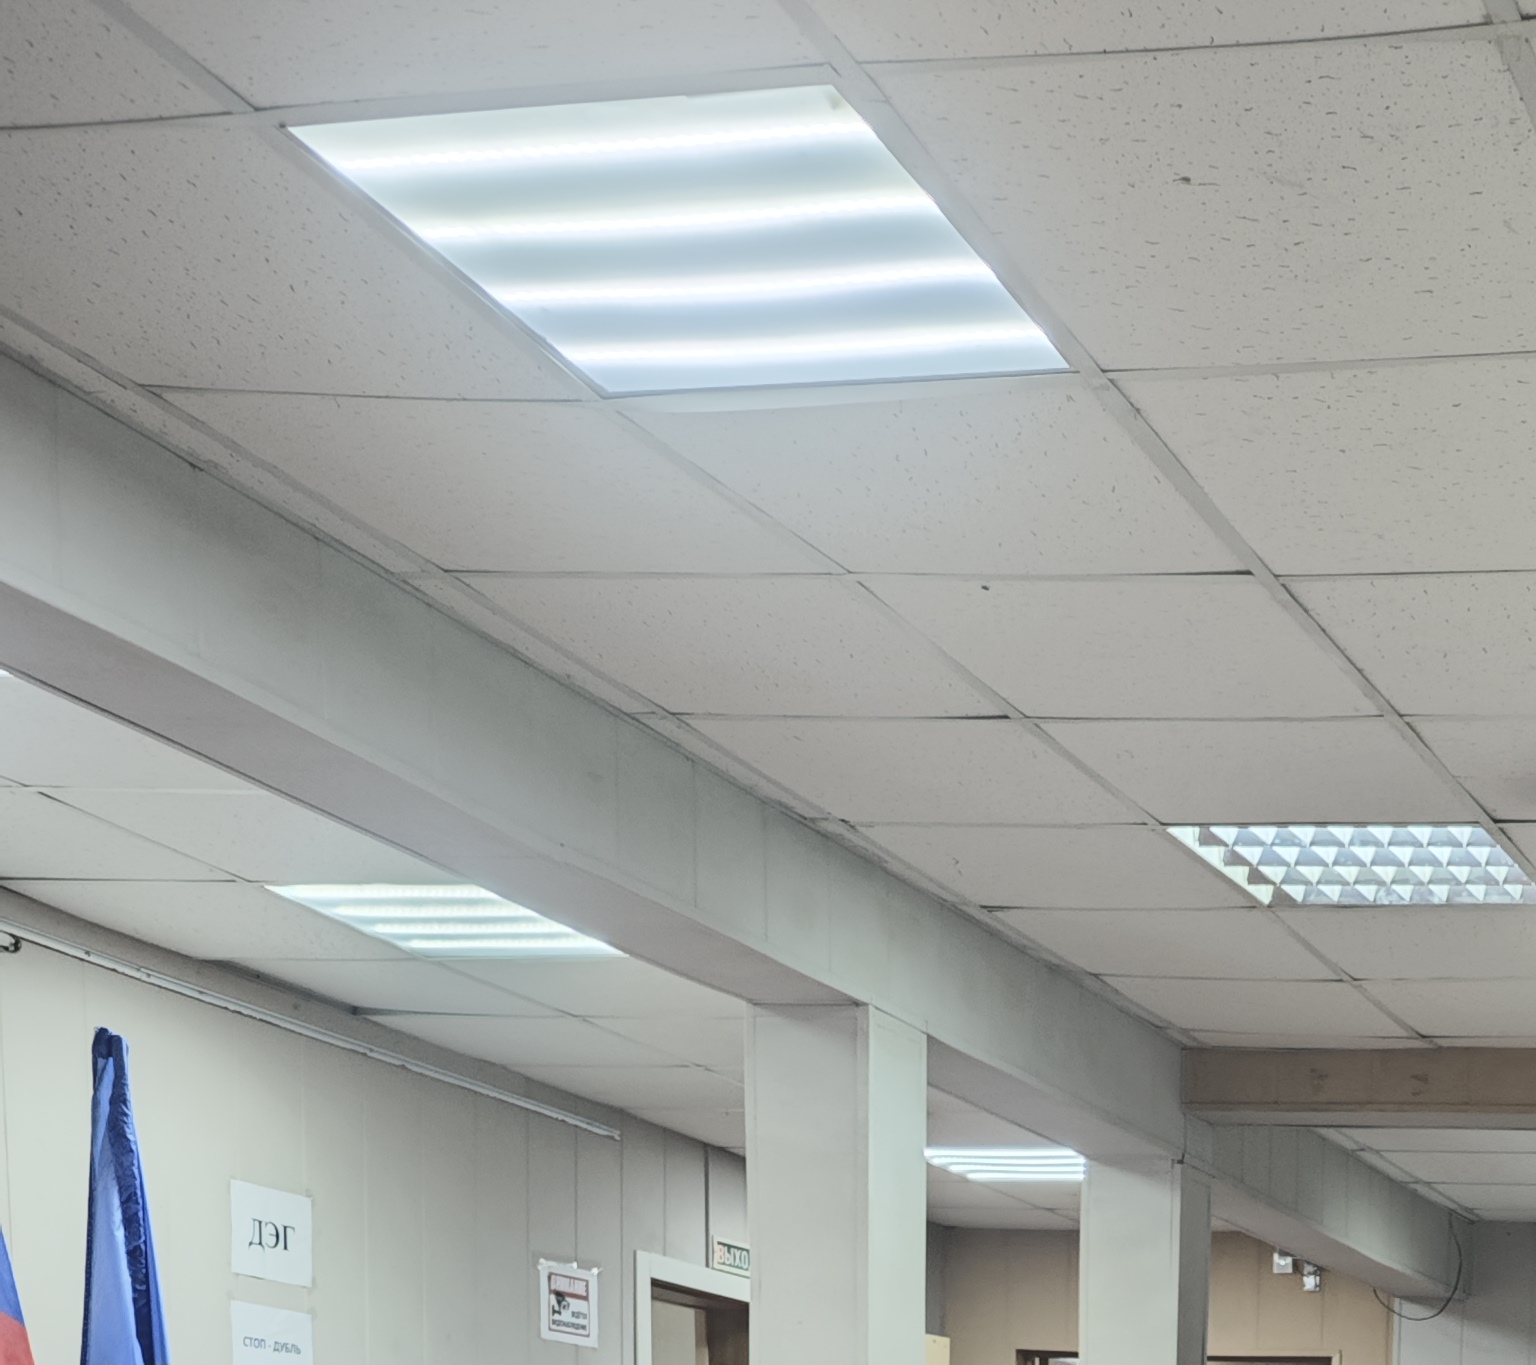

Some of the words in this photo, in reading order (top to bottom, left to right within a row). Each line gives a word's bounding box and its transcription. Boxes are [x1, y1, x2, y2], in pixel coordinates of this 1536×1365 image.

[249, 1217, 295, 1252] ДЭГ
[243, 1336, 266, 1350] СТОП
[272, 1340, 301, 1355] ДУБЛЬ
